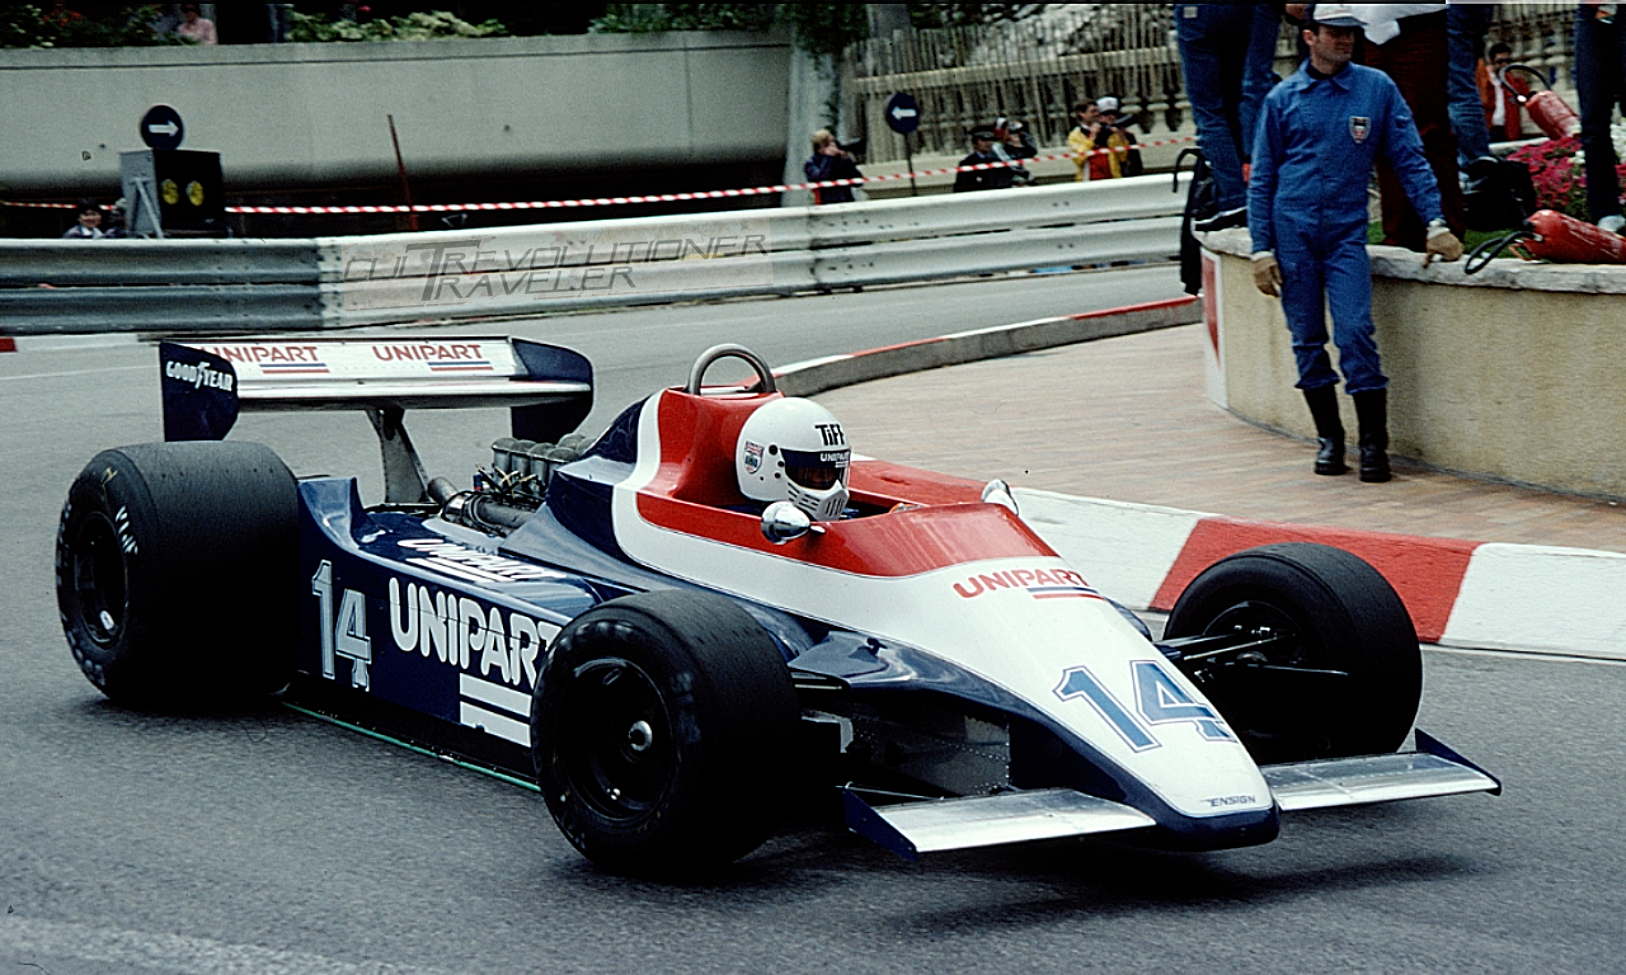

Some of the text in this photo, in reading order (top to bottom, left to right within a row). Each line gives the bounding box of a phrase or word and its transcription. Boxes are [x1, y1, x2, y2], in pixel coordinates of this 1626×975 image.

[372, 344, 483, 361] UNIPART
[166, 361, 234, 392] GOODYEAR
[952, 568, 1090, 598] UNIPART
[311, 558, 372, 692] 14
[1052, 659, 1238, 754] 14
[1200, 795, 1256, 807] ENSIGN
